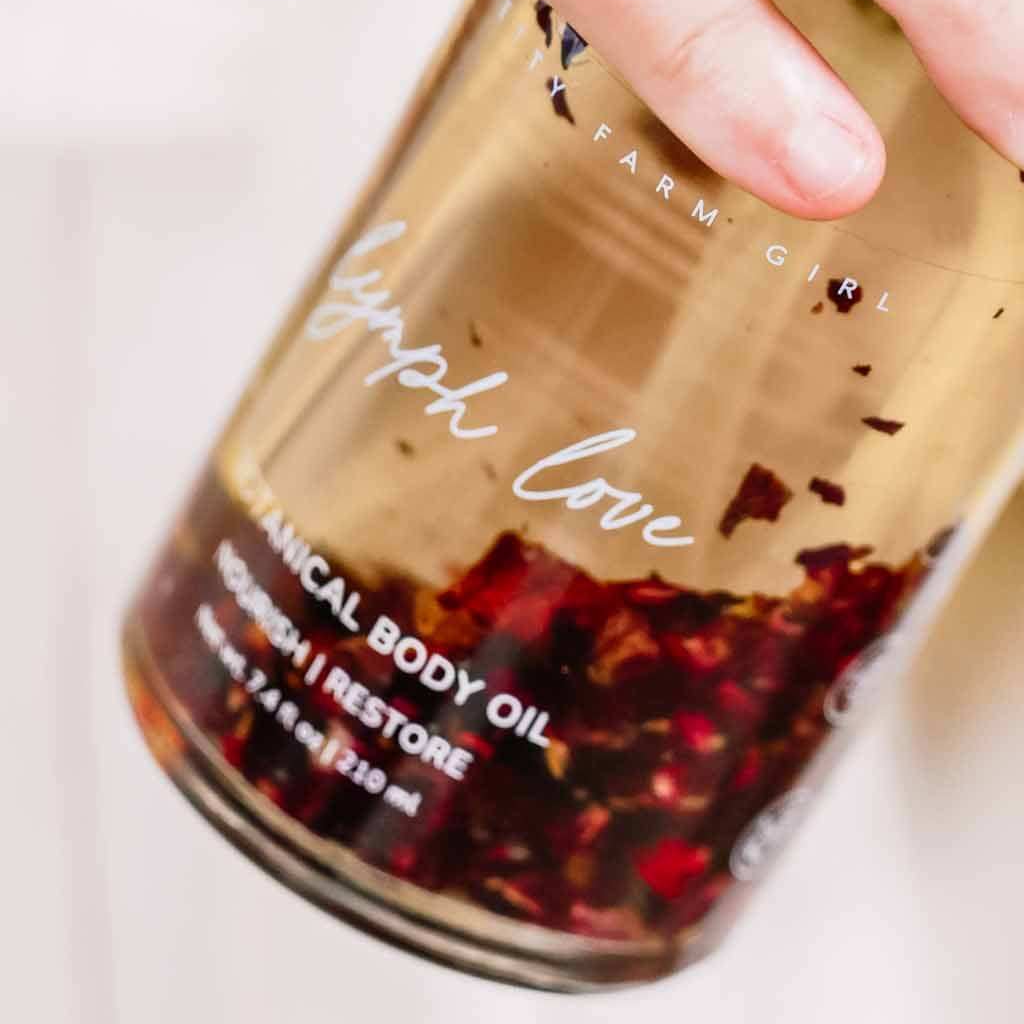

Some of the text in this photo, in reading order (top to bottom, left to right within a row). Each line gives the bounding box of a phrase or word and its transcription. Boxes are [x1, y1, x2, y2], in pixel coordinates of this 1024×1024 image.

[592, 122, 890, 313] FARM GIRL
[304, 220, 696, 547] lymph love
[322, 666, 475, 781] RESTORE
[366, 615, 487, 706] BODY
[485, 693, 552, 750] OIL
[336, 747, 388, 795] 210
